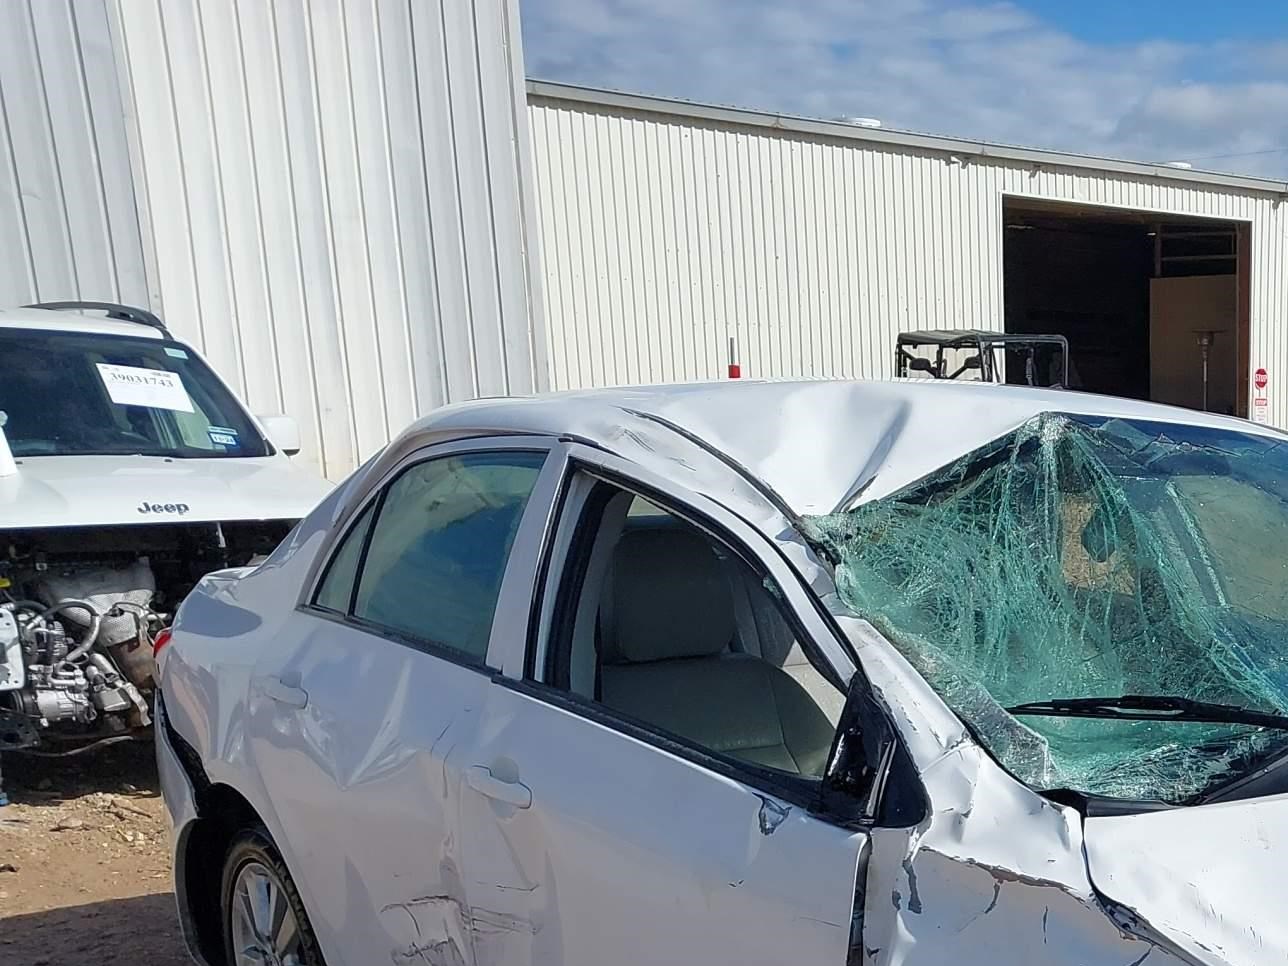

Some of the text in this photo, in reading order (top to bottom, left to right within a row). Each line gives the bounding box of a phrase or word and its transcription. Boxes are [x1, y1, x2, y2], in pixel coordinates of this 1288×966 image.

[110, 372, 174, 388] 39031743
[1255, 373, 1268, 383] STOP
[137, 501, 190, 516] Jeep
